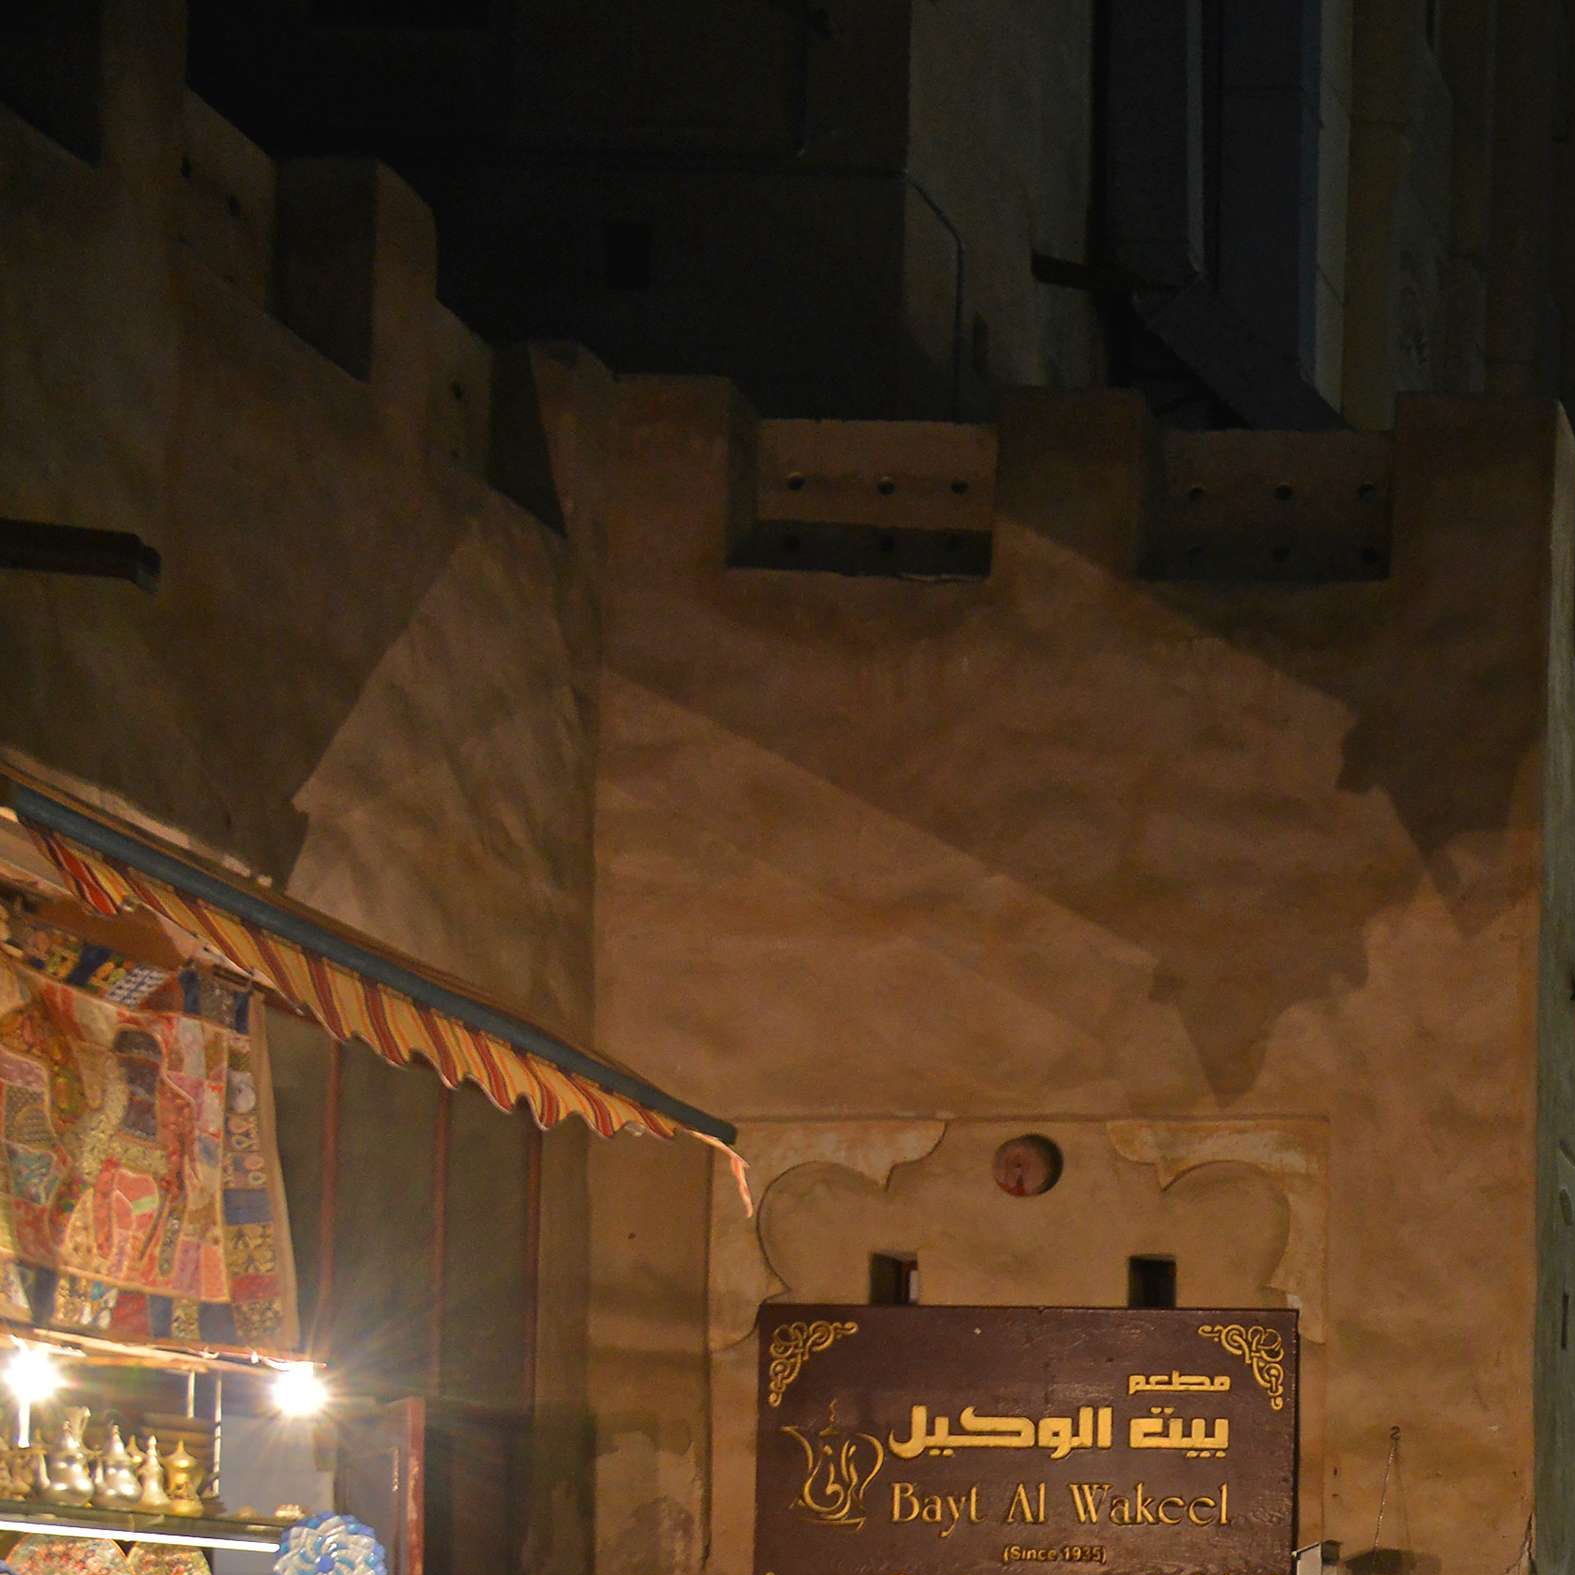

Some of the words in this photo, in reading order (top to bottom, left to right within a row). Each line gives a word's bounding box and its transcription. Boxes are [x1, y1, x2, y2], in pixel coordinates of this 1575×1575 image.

[1127, 1370, 1231, 1396] مطعم
[888, 1404, 1113, 1460] الوكيل
[1129, 1406, 1230, 1459] بيت
[890, 1480, 985, 1537] Bayt
[1006, 1482, 1047, 1524] Al
[1068, 1480, 1231, 1527] Wakeel
[1003, 1544, 1057, 1564] (Since
[1062, 1544, 1107, 1564] 1935)
